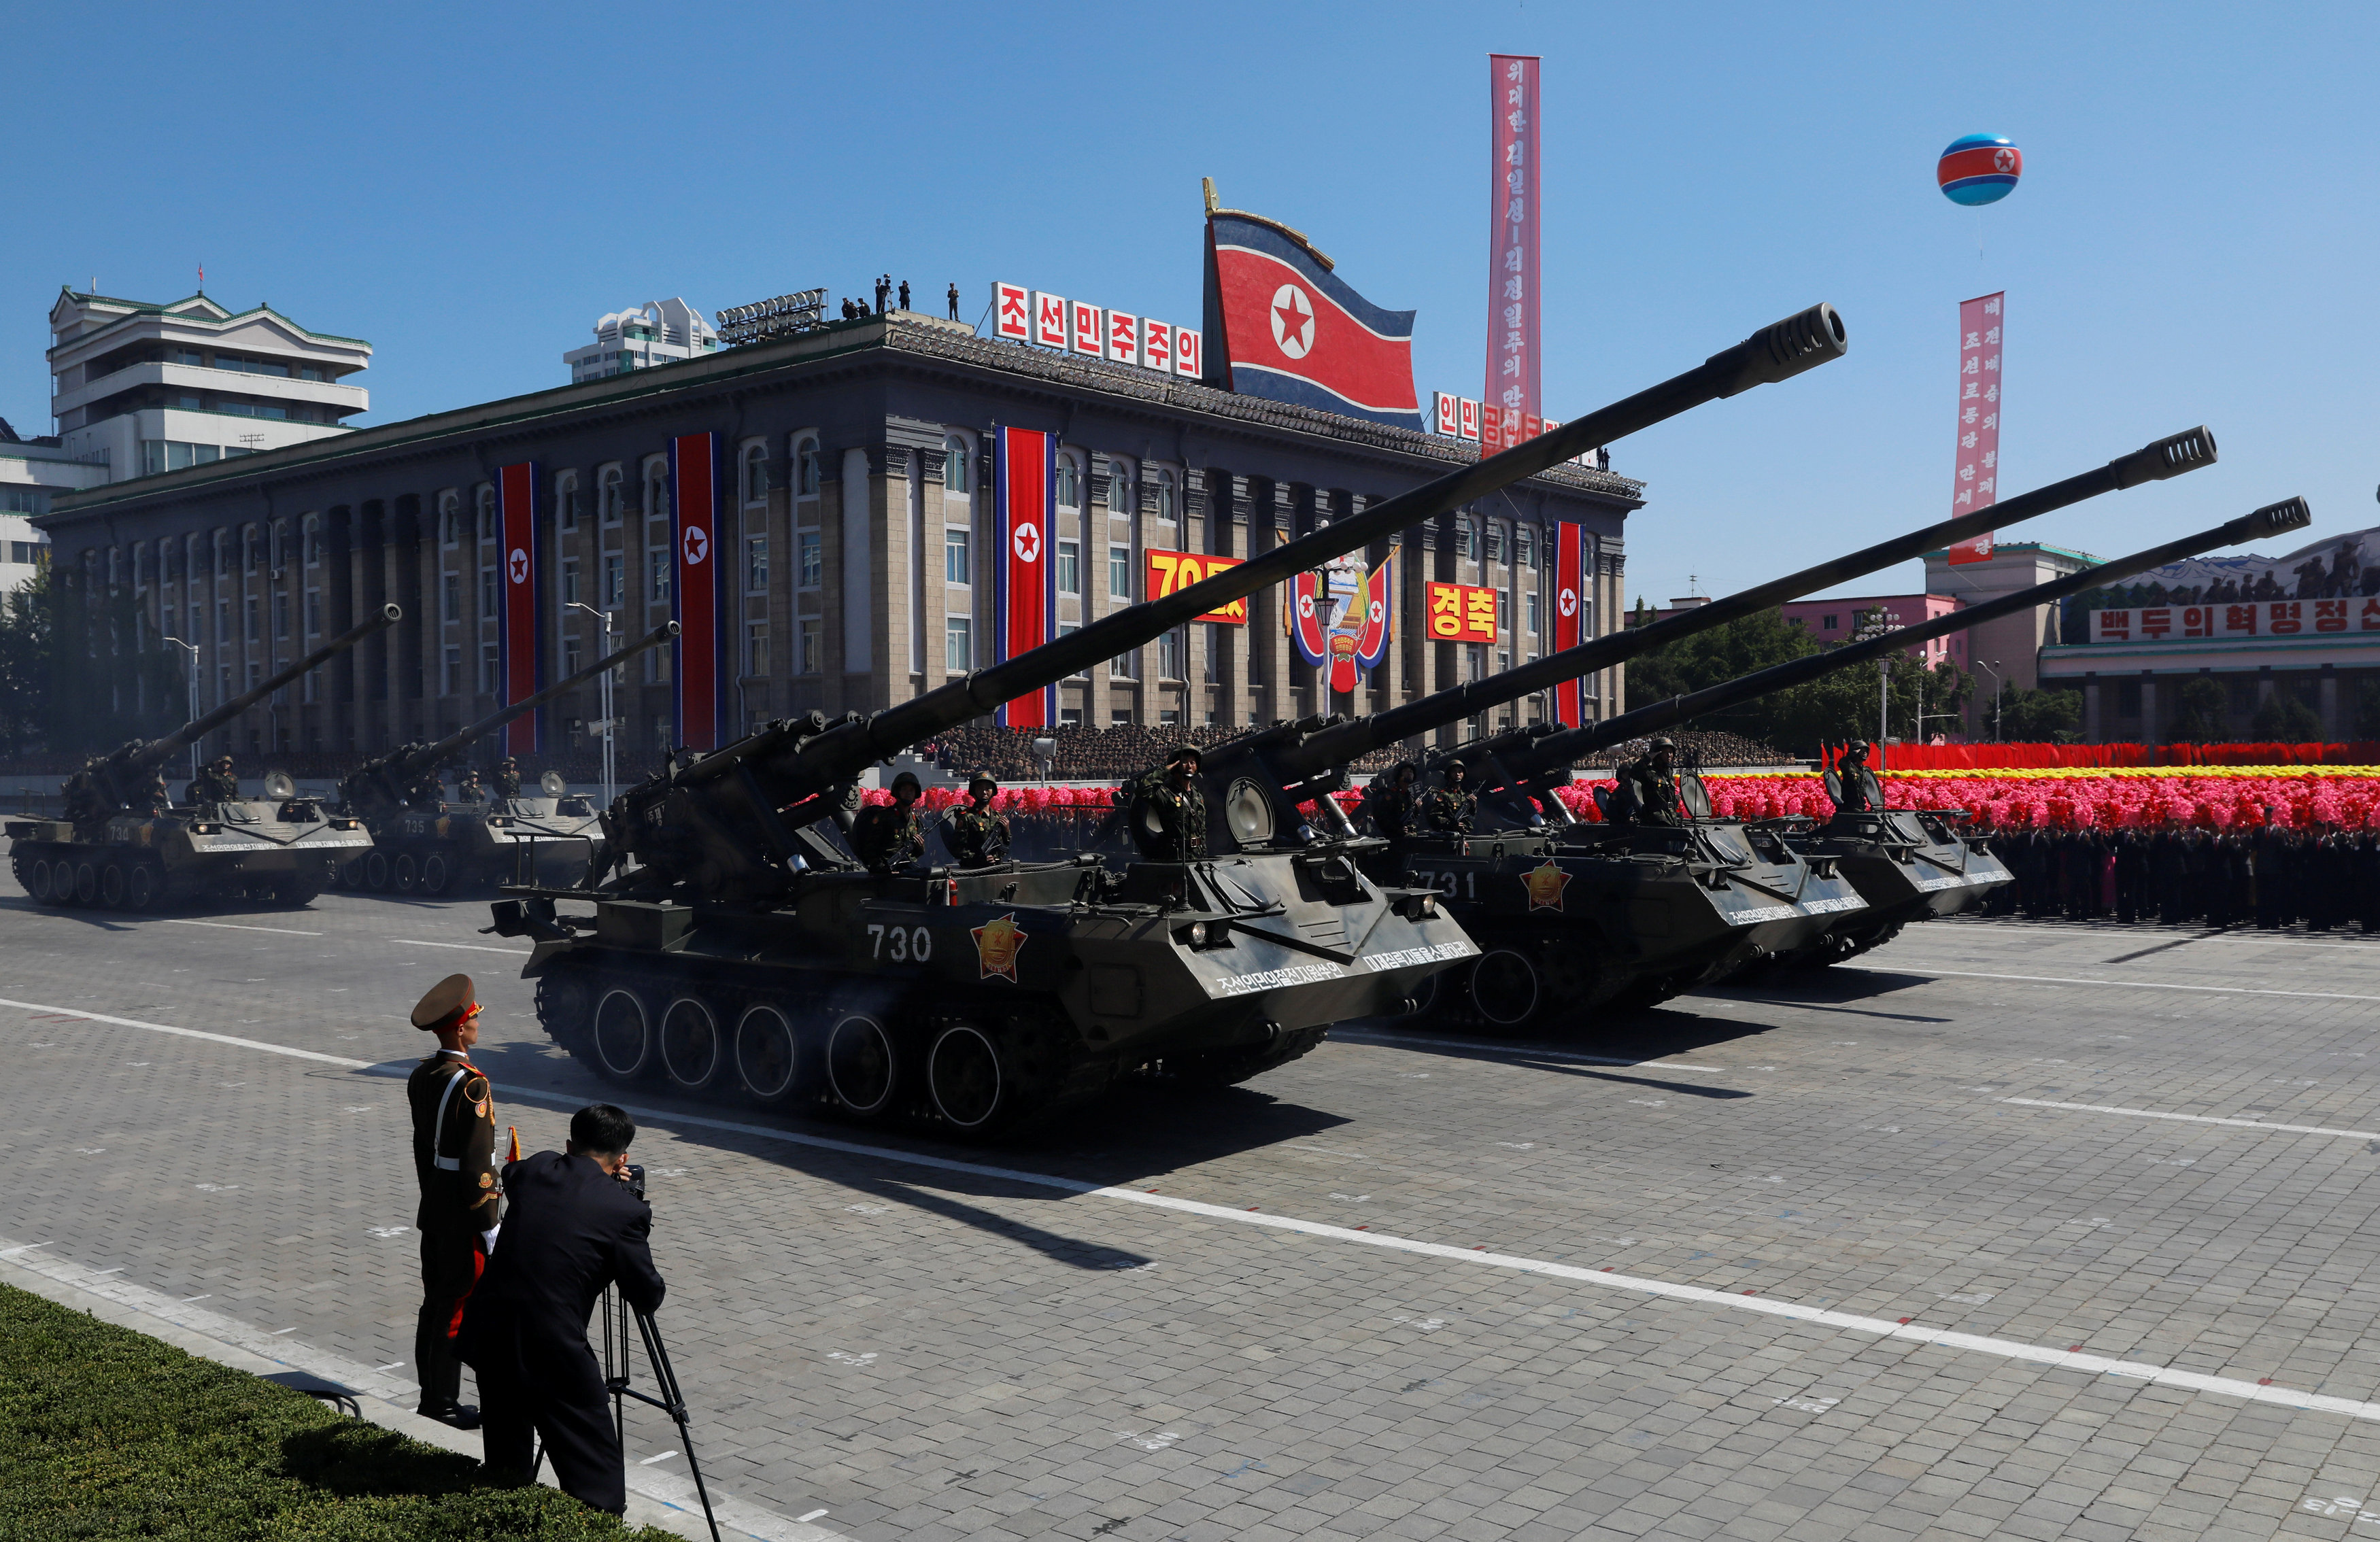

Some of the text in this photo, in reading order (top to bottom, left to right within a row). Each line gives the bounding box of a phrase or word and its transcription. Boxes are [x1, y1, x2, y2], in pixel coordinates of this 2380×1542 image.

[1507, 60, 1527, 133] 위대한
[1502, 140, 1525, 378] 김일성-김정일주의
[1002, 287, 1200, 375] 조선민주주의
[1961, 331, 1981, 448] 조선로동당
[1433, 587, 1495, 638] 경축
[405, 819, 424, 833] 735
[1419, 871, 1475, 898] 731
[867, 924, 932, 962] 730
